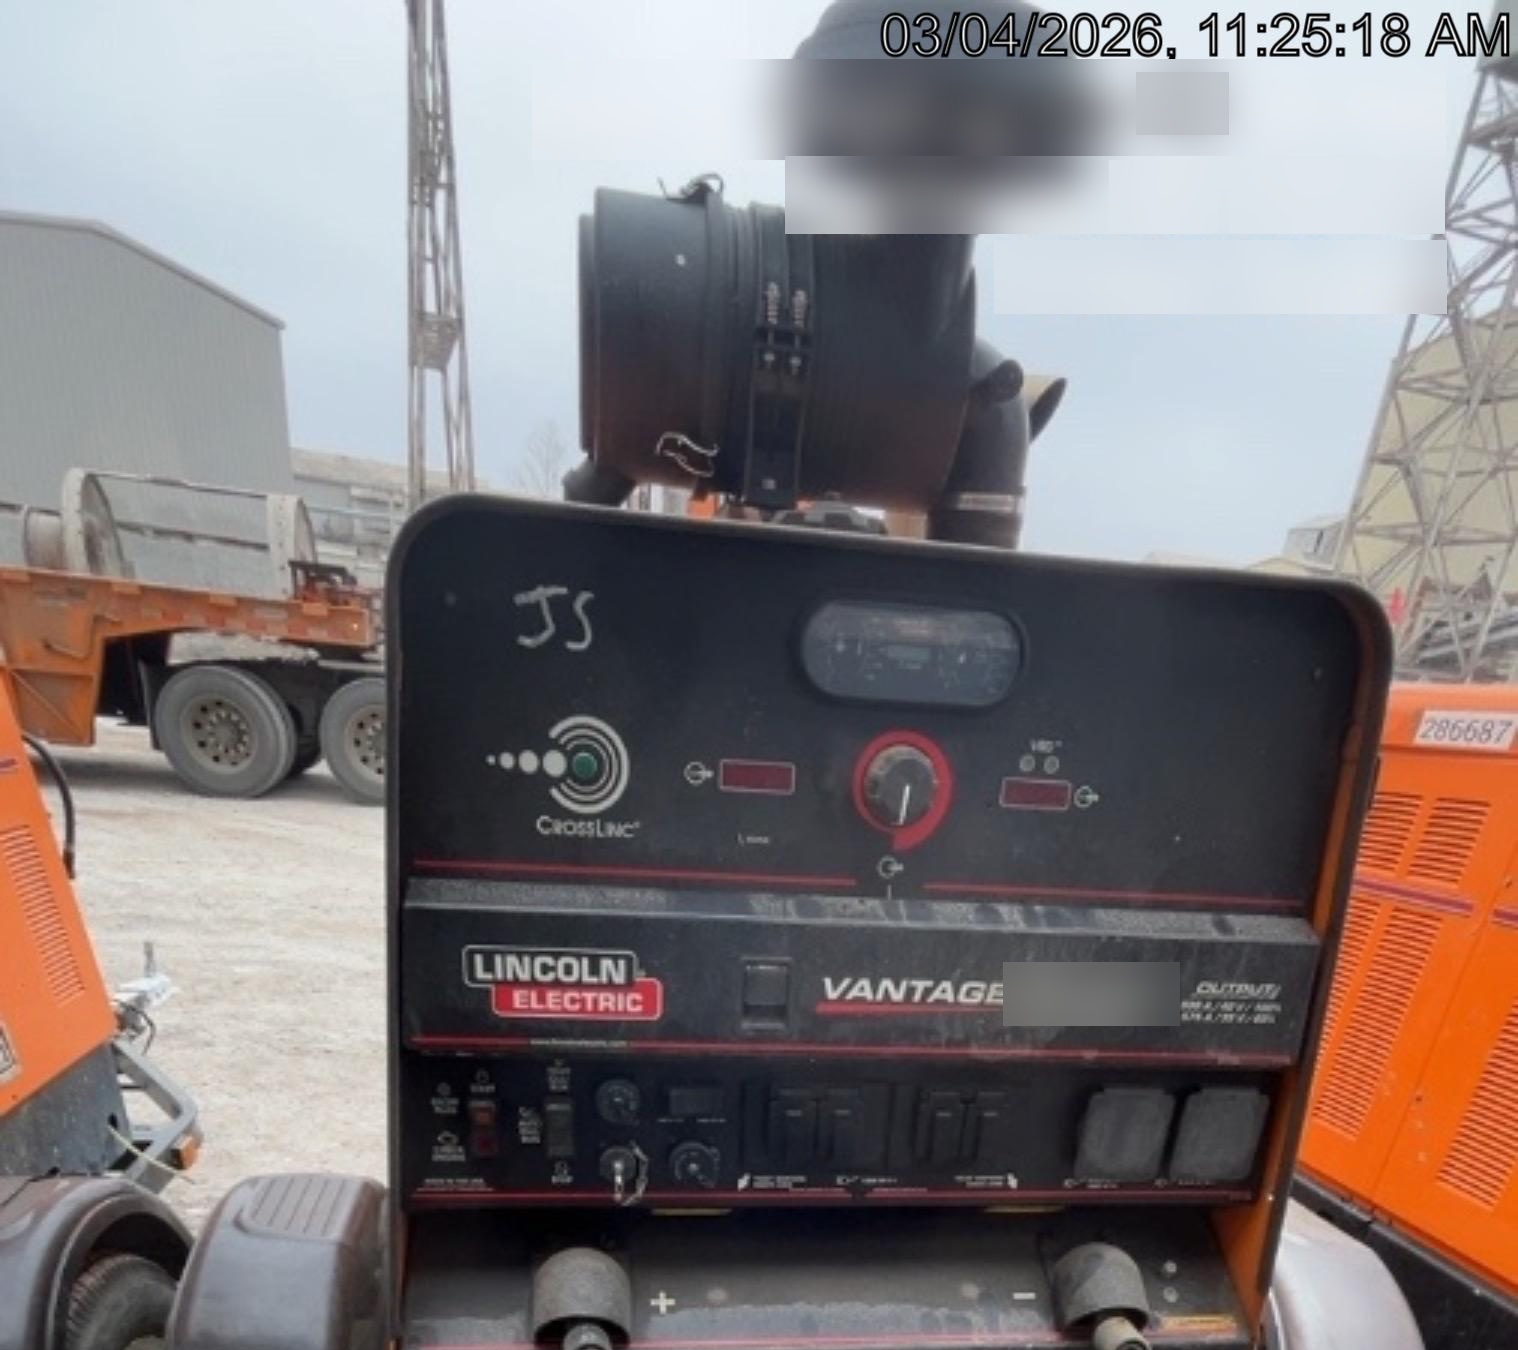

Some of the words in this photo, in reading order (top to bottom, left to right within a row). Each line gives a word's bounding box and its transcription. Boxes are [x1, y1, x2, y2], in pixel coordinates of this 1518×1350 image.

[513, 585, 595, 651] JS
[1420, 717, 1513, 744] 286687
[473, 953, 626, 985] LINCOLN
[512, 989, 644, 1013] ELECTRIC
[822, 976, 1004, 1005] VANTAGE
